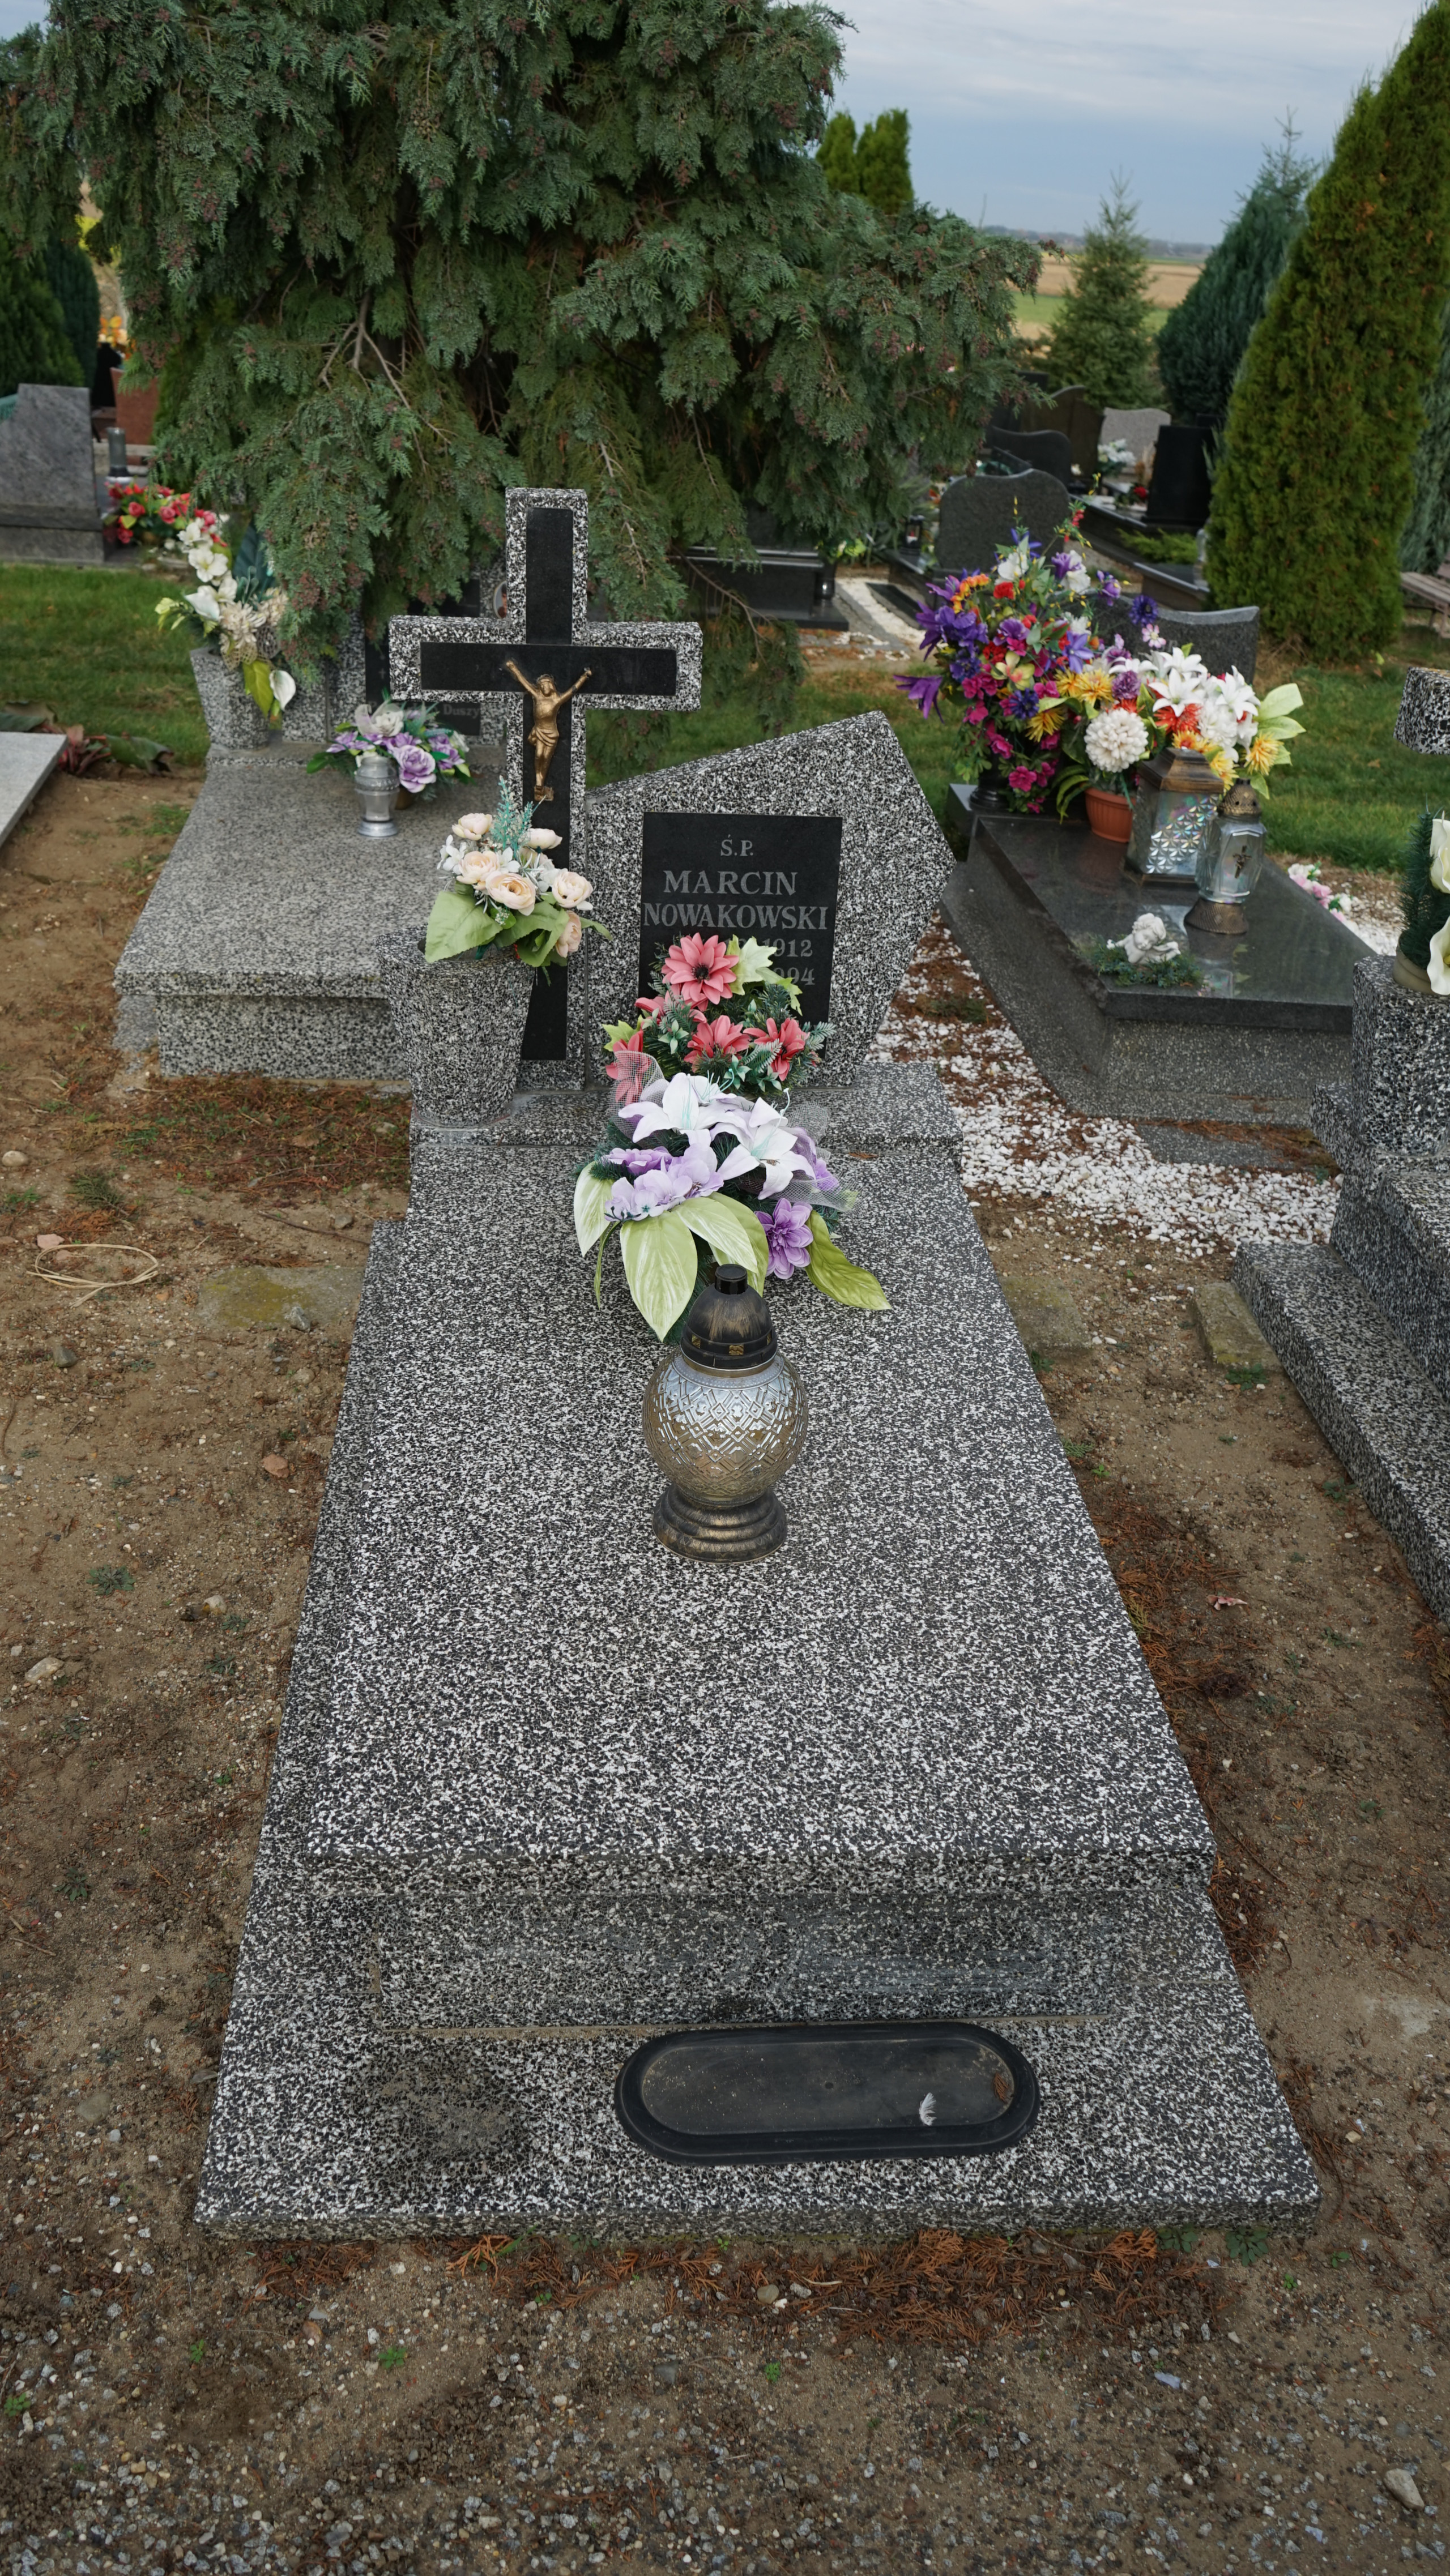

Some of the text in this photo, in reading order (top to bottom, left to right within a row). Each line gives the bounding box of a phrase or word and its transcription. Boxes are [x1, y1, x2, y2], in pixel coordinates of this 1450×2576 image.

[443, 704, 480, 719] Duszy
[663, 870, 799, 896] MARCIN
[642, 902, 829, 930] NOWAKOWSKI
